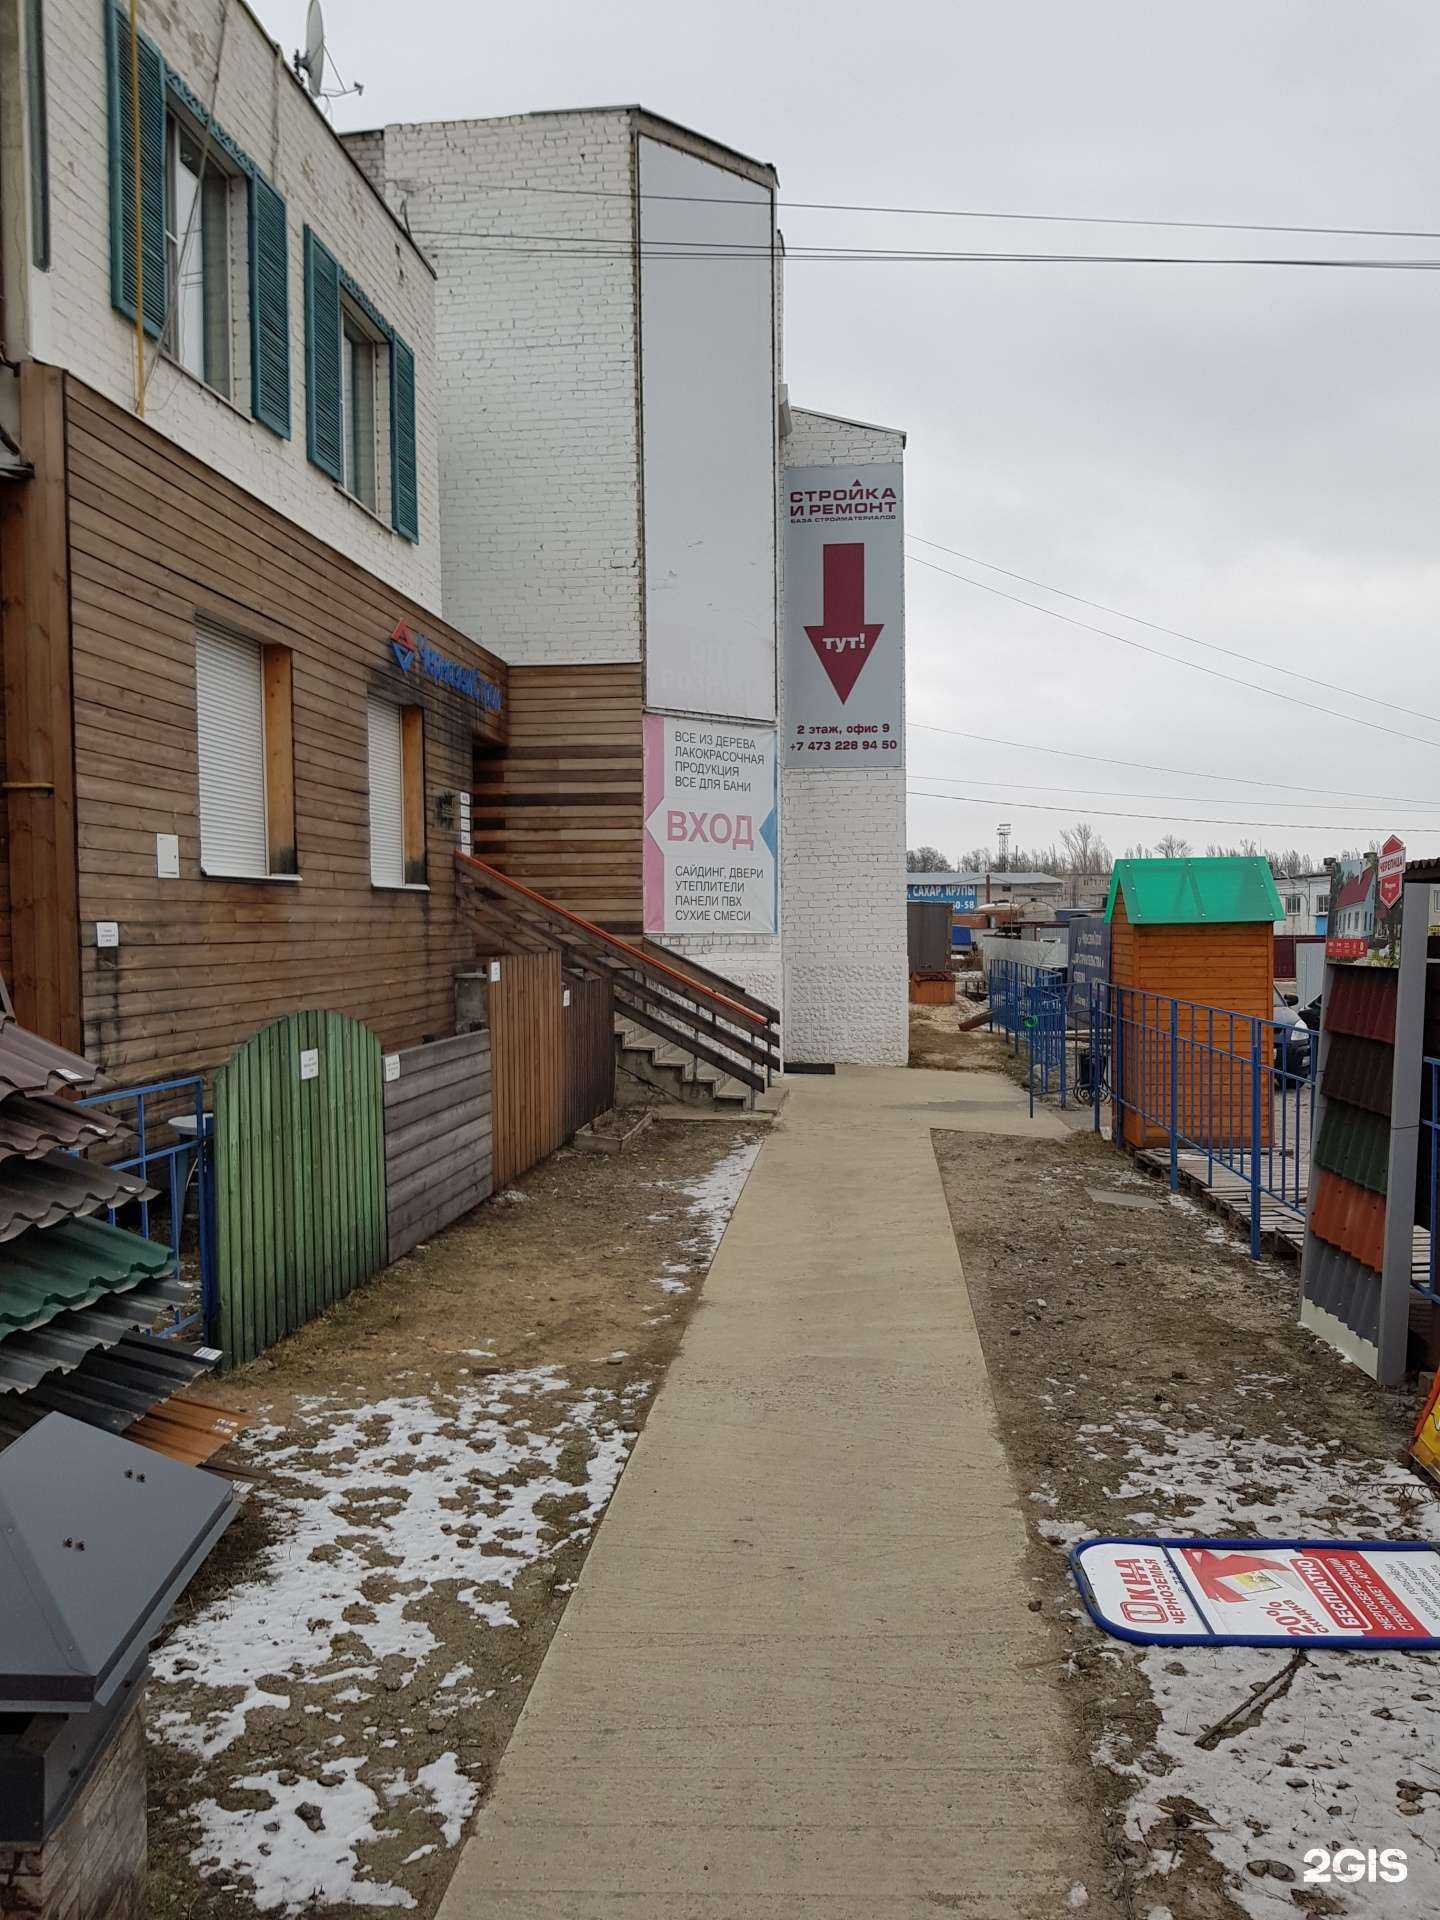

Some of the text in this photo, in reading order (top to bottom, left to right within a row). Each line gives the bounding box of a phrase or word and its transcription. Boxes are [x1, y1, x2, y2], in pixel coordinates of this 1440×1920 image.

[790, 482, 897, 503] СТРОЙКА
[790, 502, 897, 517] И РЕМОНТ
[822, 633, 866, 653] тут!
[796, 723, 890, 736] 2 этаж, офис 9
[674, 731, 756, 750] ВСЕ ИЗ ДЕРЕВА
[790, 740, 897, 751] +7 473 228 94 50
[674, 746, 765, 765] ЛАКОКРАСОЧНАЯ
[675, 761, 740, 778] ПРОДУКЦИЯ
[674, 776, 751, 792] ВСЕ ДЛЯ БАНИ
[667, 810, 754, 851] ВХОД
[675, 864, 764, 879] САЙДИНГ, ДВЕРИ
[675, 880, 745, 892] УТЕПЛИТЕЛИ
[912, 885, 944, 899] САХАР,
[945, 884, 976, 896] КРУПЫ
[675, 895, 742, 907] ПАНЕЛИ ПВХ
[675, 910, 751, 921] СУХИЕ СМЕСИ
[1144, 1558, 1188, 1624] ЧЕРНОЗЕМЬЯ
[1297, 1560, 1361, 1626] БЕСПЛАТНО
[1259, 1600, 1316, 1636] 20%
[1282, 1599, 1330, 1634] скидка
